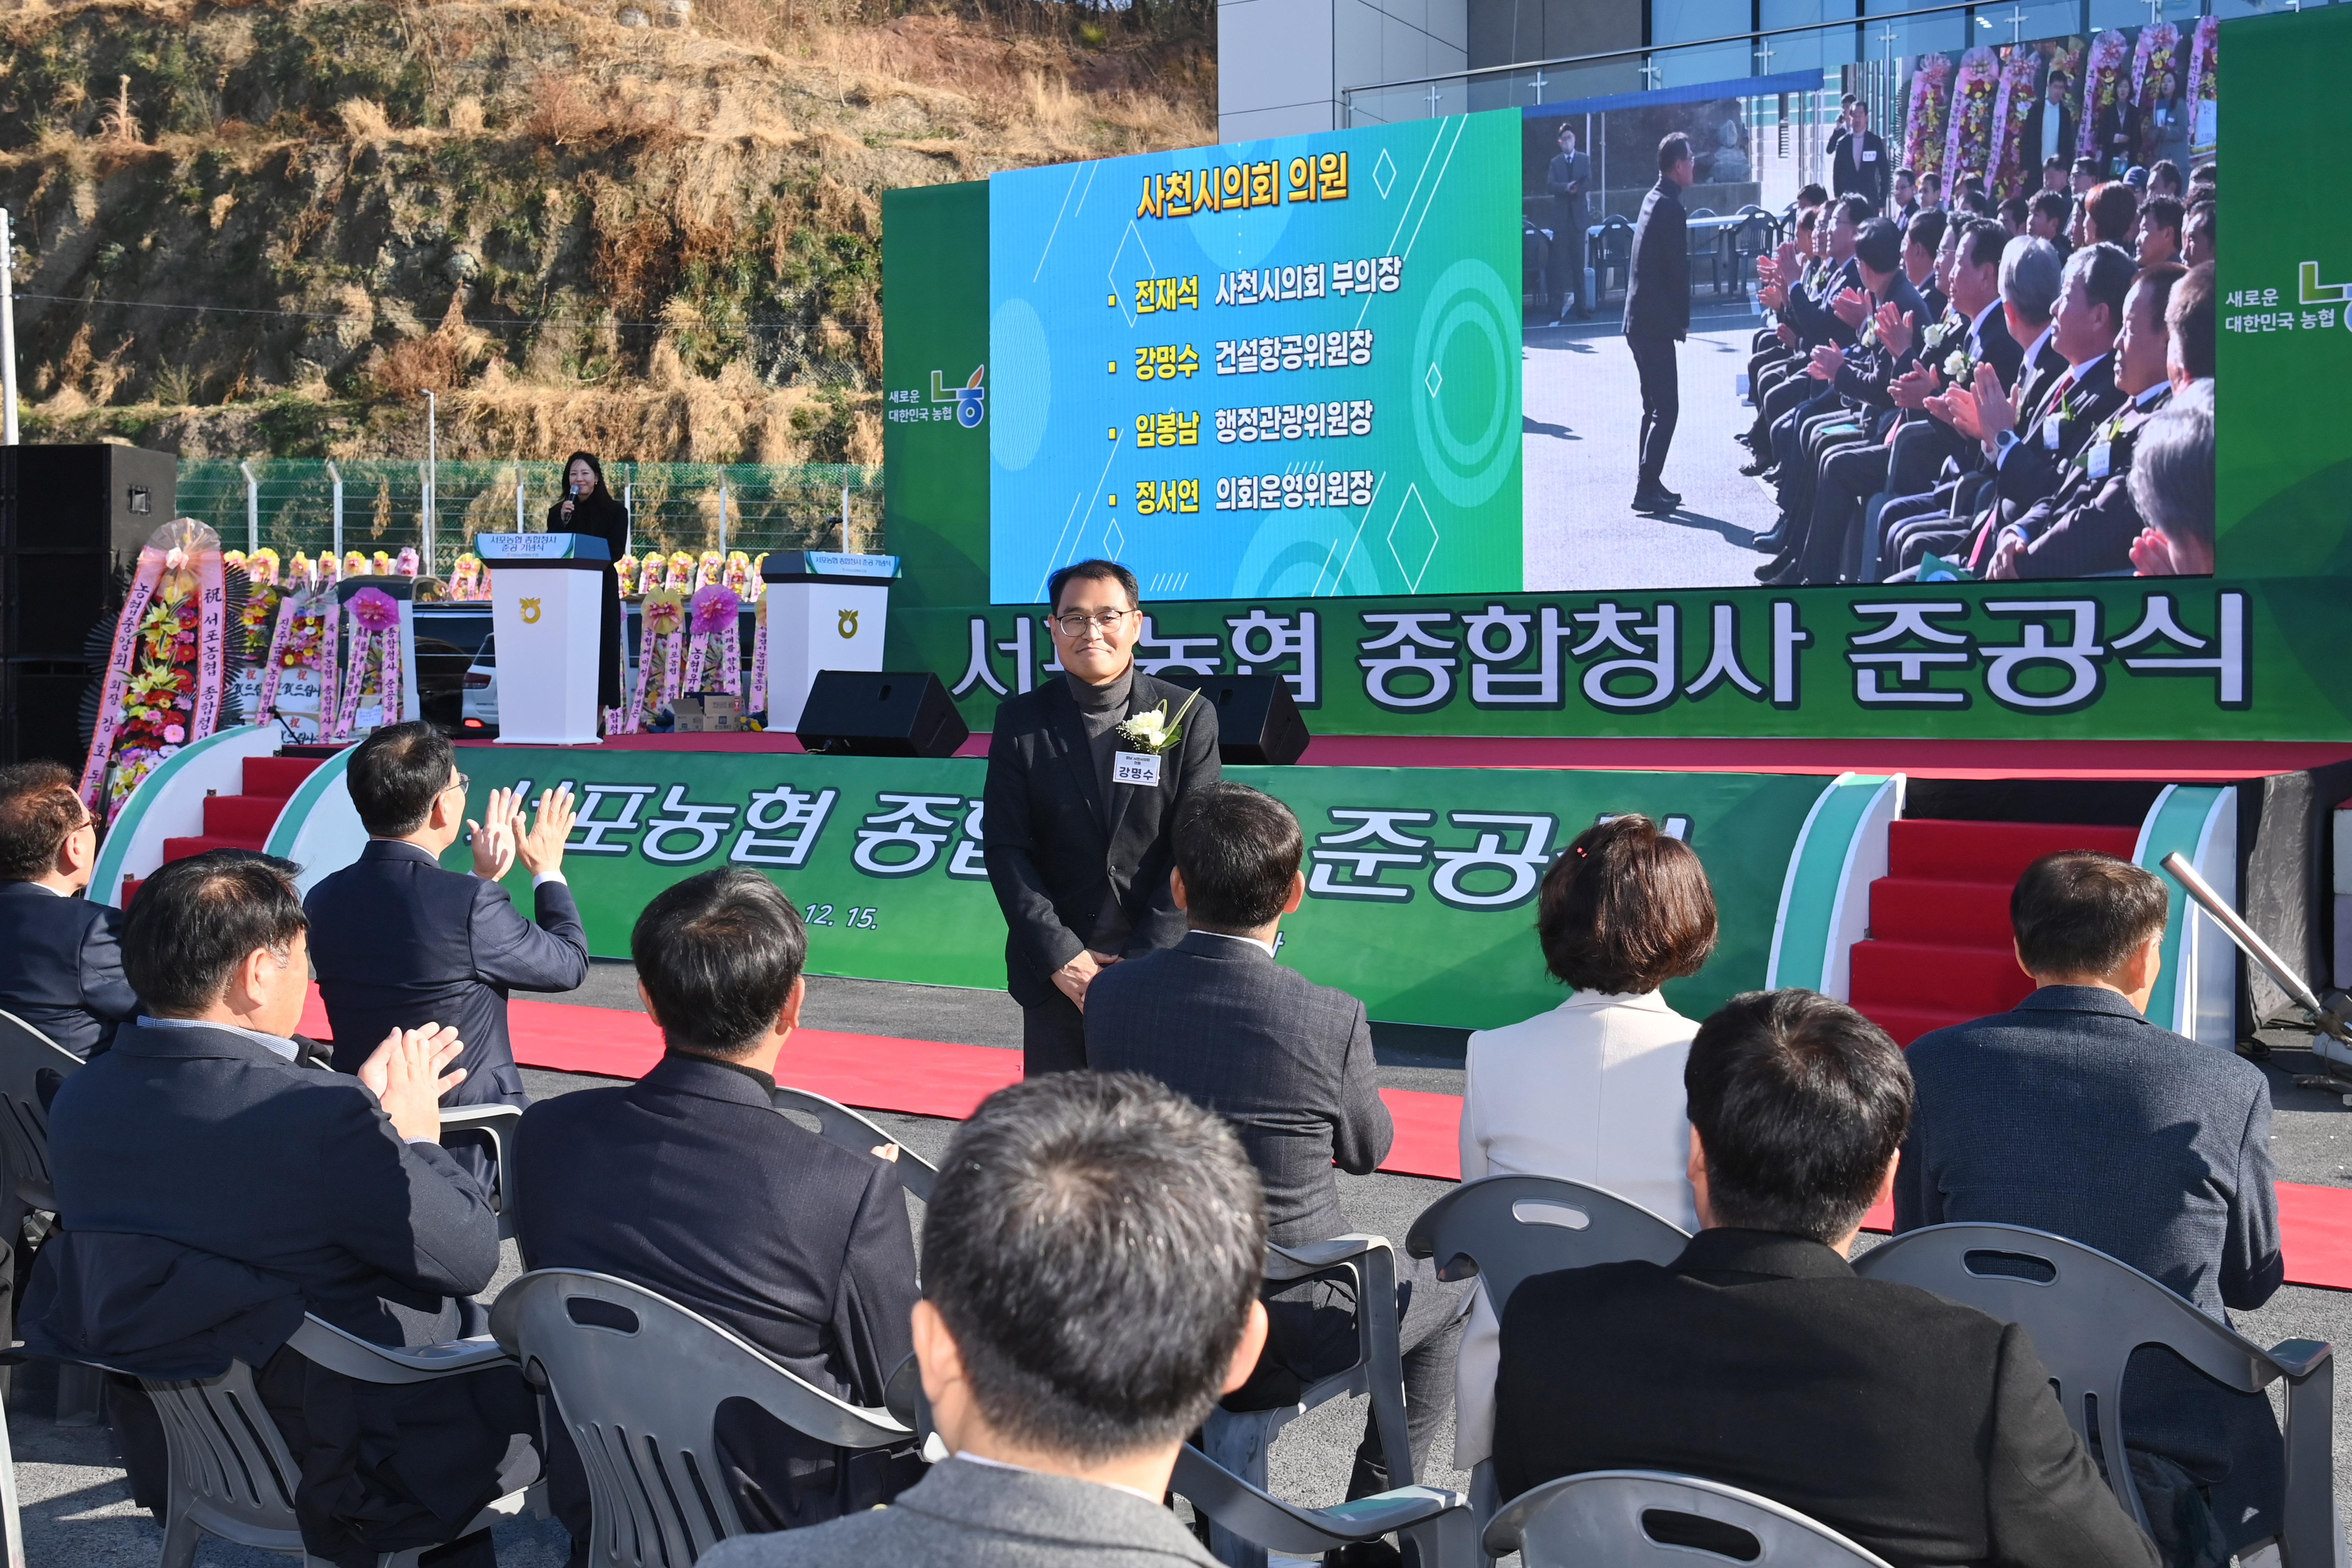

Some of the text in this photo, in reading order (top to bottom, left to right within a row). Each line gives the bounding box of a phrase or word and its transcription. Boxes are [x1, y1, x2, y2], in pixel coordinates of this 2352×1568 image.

[1136, 152, 1349, 219] 사천시의회 의원
[1135, 256, 1402, 313] 전재석 사천시의회 부의장
[2225, 288, 2279, 308] 새로운
[2225, 308, 2335, 333] 대한민국 농협
[1135, 329, 1373, 381] 강명수 건설항공위원장
[889, 389, 920, 403] 새로운
[889, 406, 952, 423] 대한민국 농협
[1135, 400, 1373, 448] 임봉남 행정관광위원장
[1135, 471, 1373, 514] 정서연 의회운영위원장
[520, 544, 544, 552] 기념식
[525, 536, 556, 544] 종합청사
[204, 588, 222, 603] 祝
[113, 583, 149, 669] 농협중앙회
[724, 628, 735, 653] 미래를
[203, 613, 220, 676] 서포농협
[324, 640, 335, 679] 서포농협
[385, 627, 397, 671] 종합청사
[669, 642, 678, 675] 서포농협
[951, 593, 2243, 707] 서농협 종합청사 준공식
[727, 657, 736, 673] 향한
[108, 680, 121, 705] 회장
[322, 685, 333, 725] 종합청사
[384, 679, 395, 712] 준공을
[1119, 767, 1153, 780] 강명수
[805, 904, 877, 930] 12. 15.
